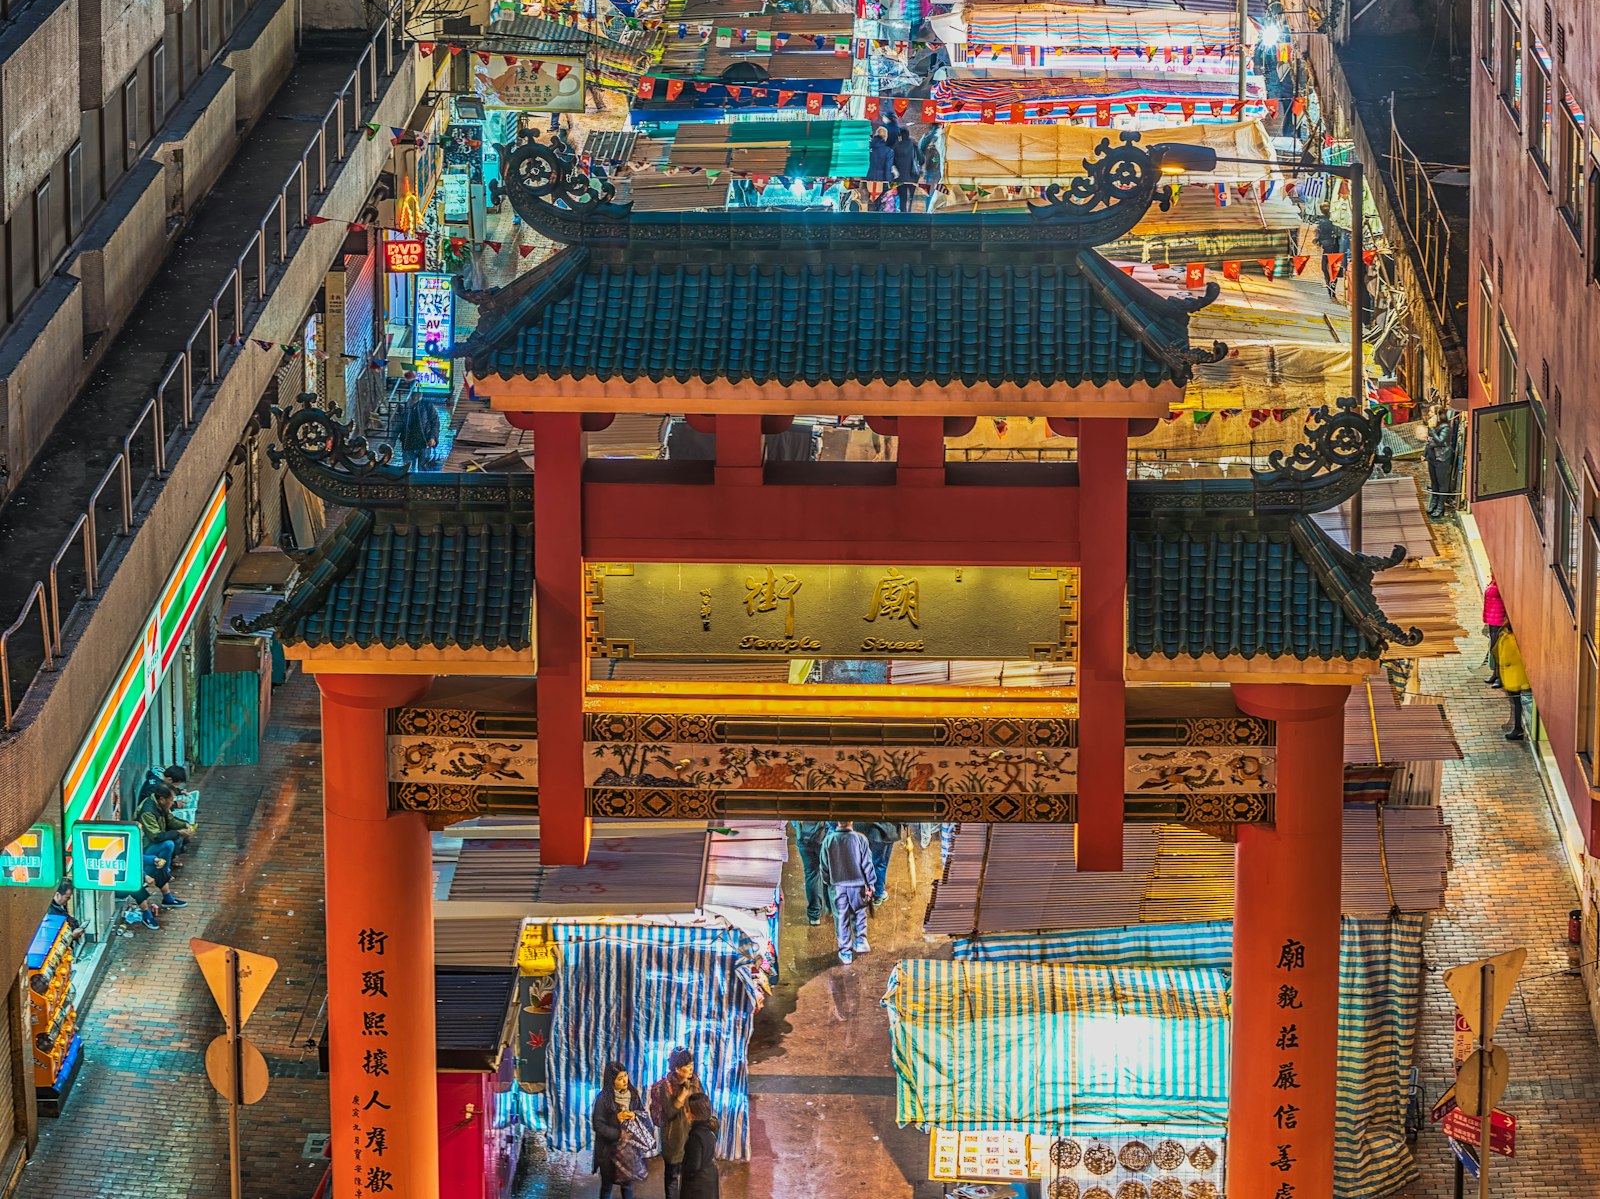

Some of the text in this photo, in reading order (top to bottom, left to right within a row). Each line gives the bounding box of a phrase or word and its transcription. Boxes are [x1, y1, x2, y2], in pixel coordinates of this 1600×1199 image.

[387, 243, 422, 255] DVD
[738, 635, 925, 654] Temple Street
[88, 836, 125, 886] 7
